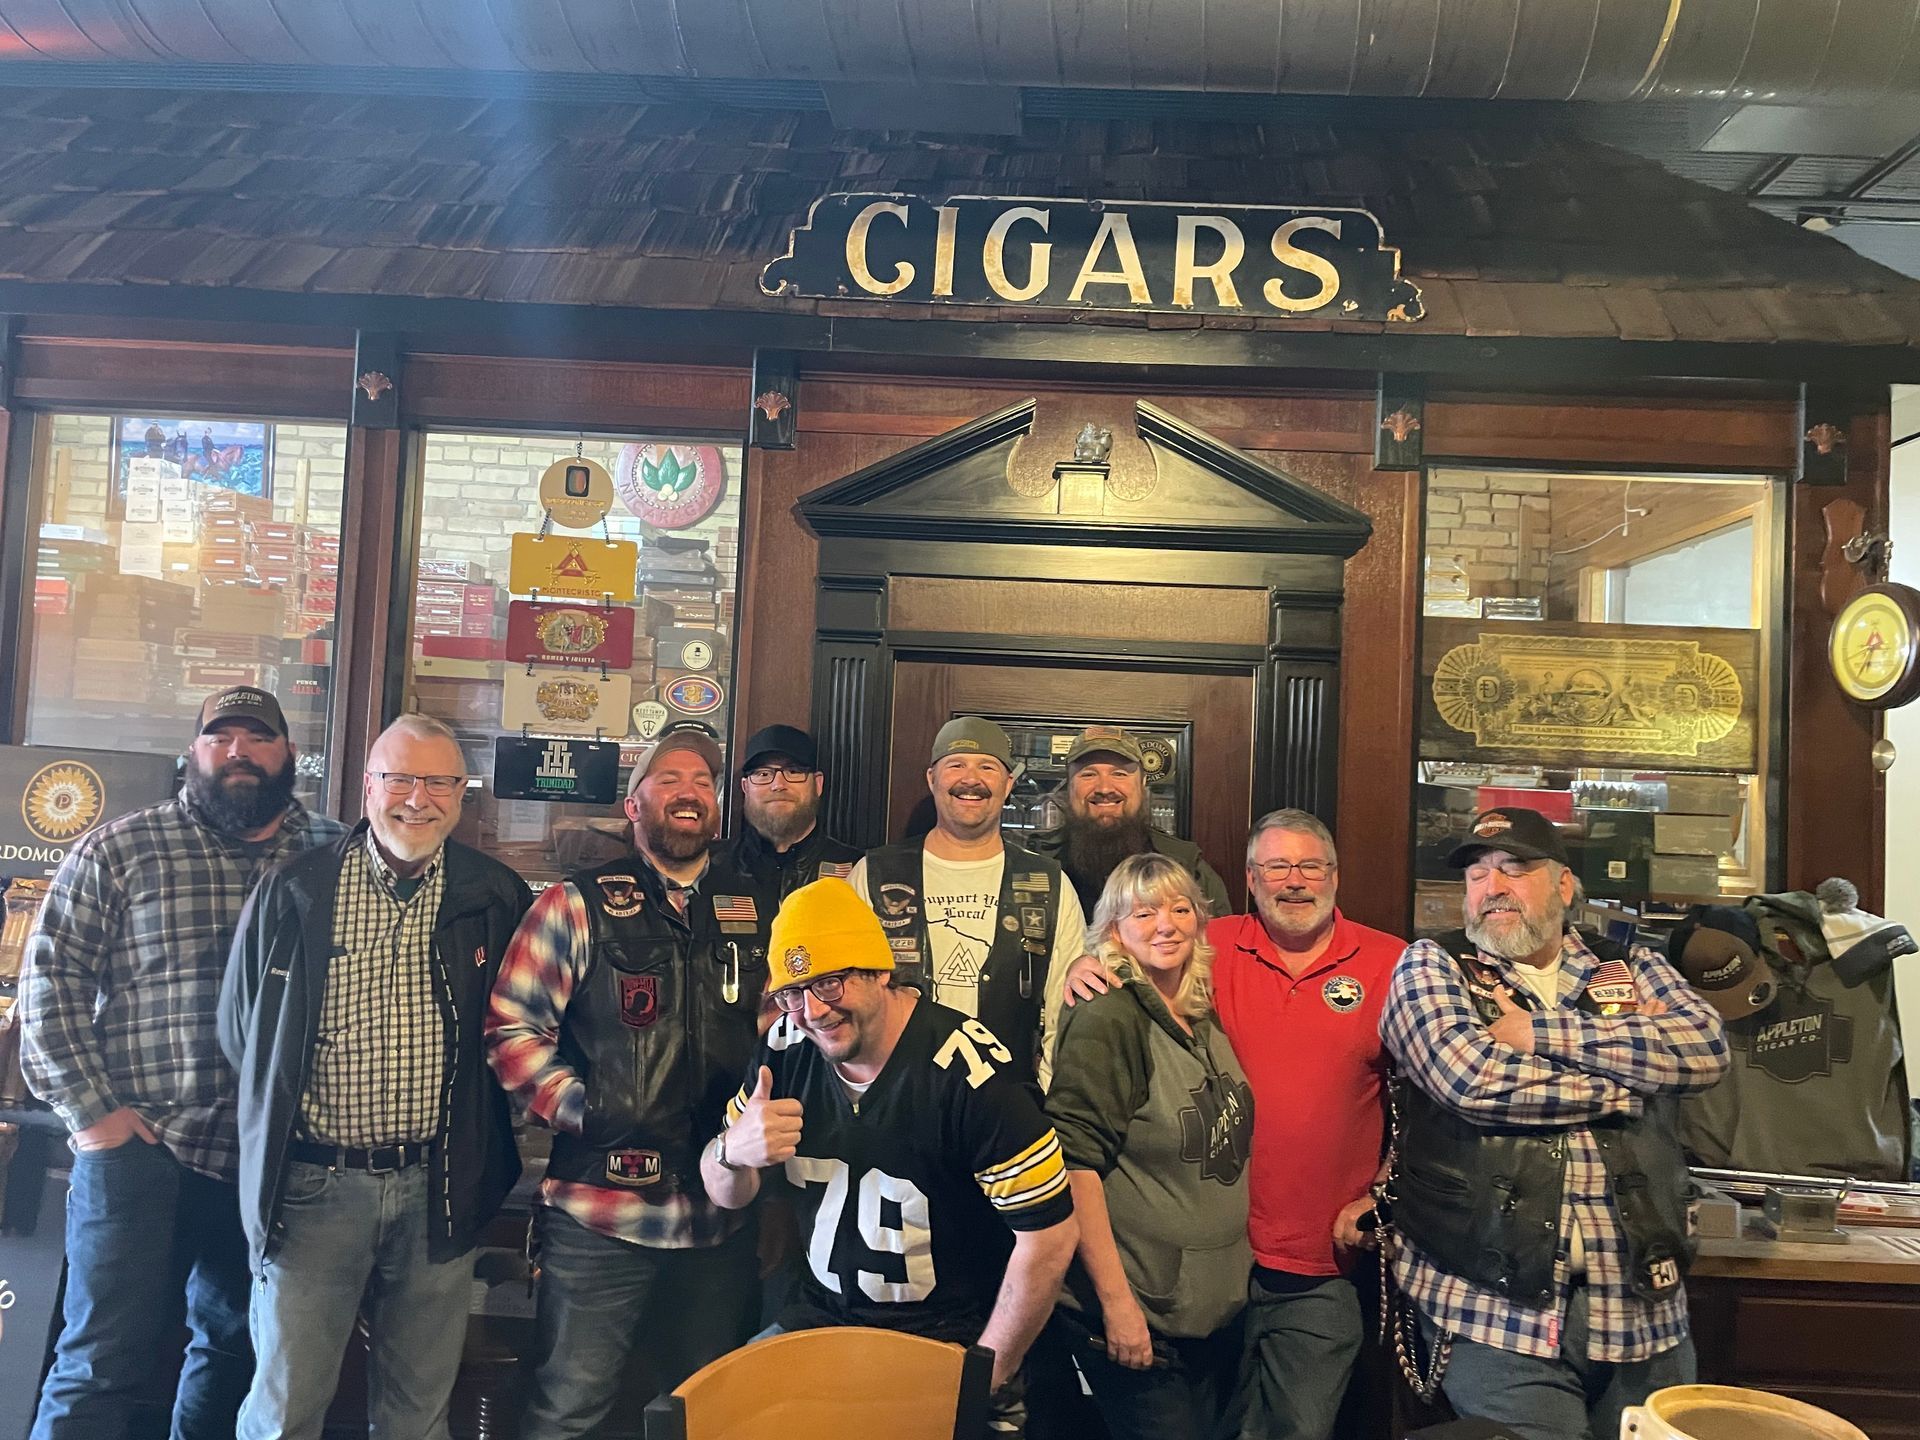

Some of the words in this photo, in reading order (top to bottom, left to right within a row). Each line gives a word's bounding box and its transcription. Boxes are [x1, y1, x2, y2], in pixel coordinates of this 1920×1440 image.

[845, 201, 1342, 313] CIGARS
[620, 482, 716, 523] NICARAGUA
[542, 586, 602, 598] MONTECRISTO
[541, 654, 564, 662] ROMEO
[571, 656, 595, 664] JULIETA
[217, 693, 263, 705] APPLETON
[1575, 728, 1617, 736] TOBACCO
[535, 778, 575, 789] TRINIDAD
[923, 893, 978, 906] upport
[944, 907, 987, 920] Local
[1703, 955, 1742, 978] APPLETON
[1757, 1013, 1823, 1042] APPLETON
[1756, 1039, 1795, 1053] CIGAR
[932, 1018, 1013, 1090] 79
[785, 1156, 937, 1304] 79
